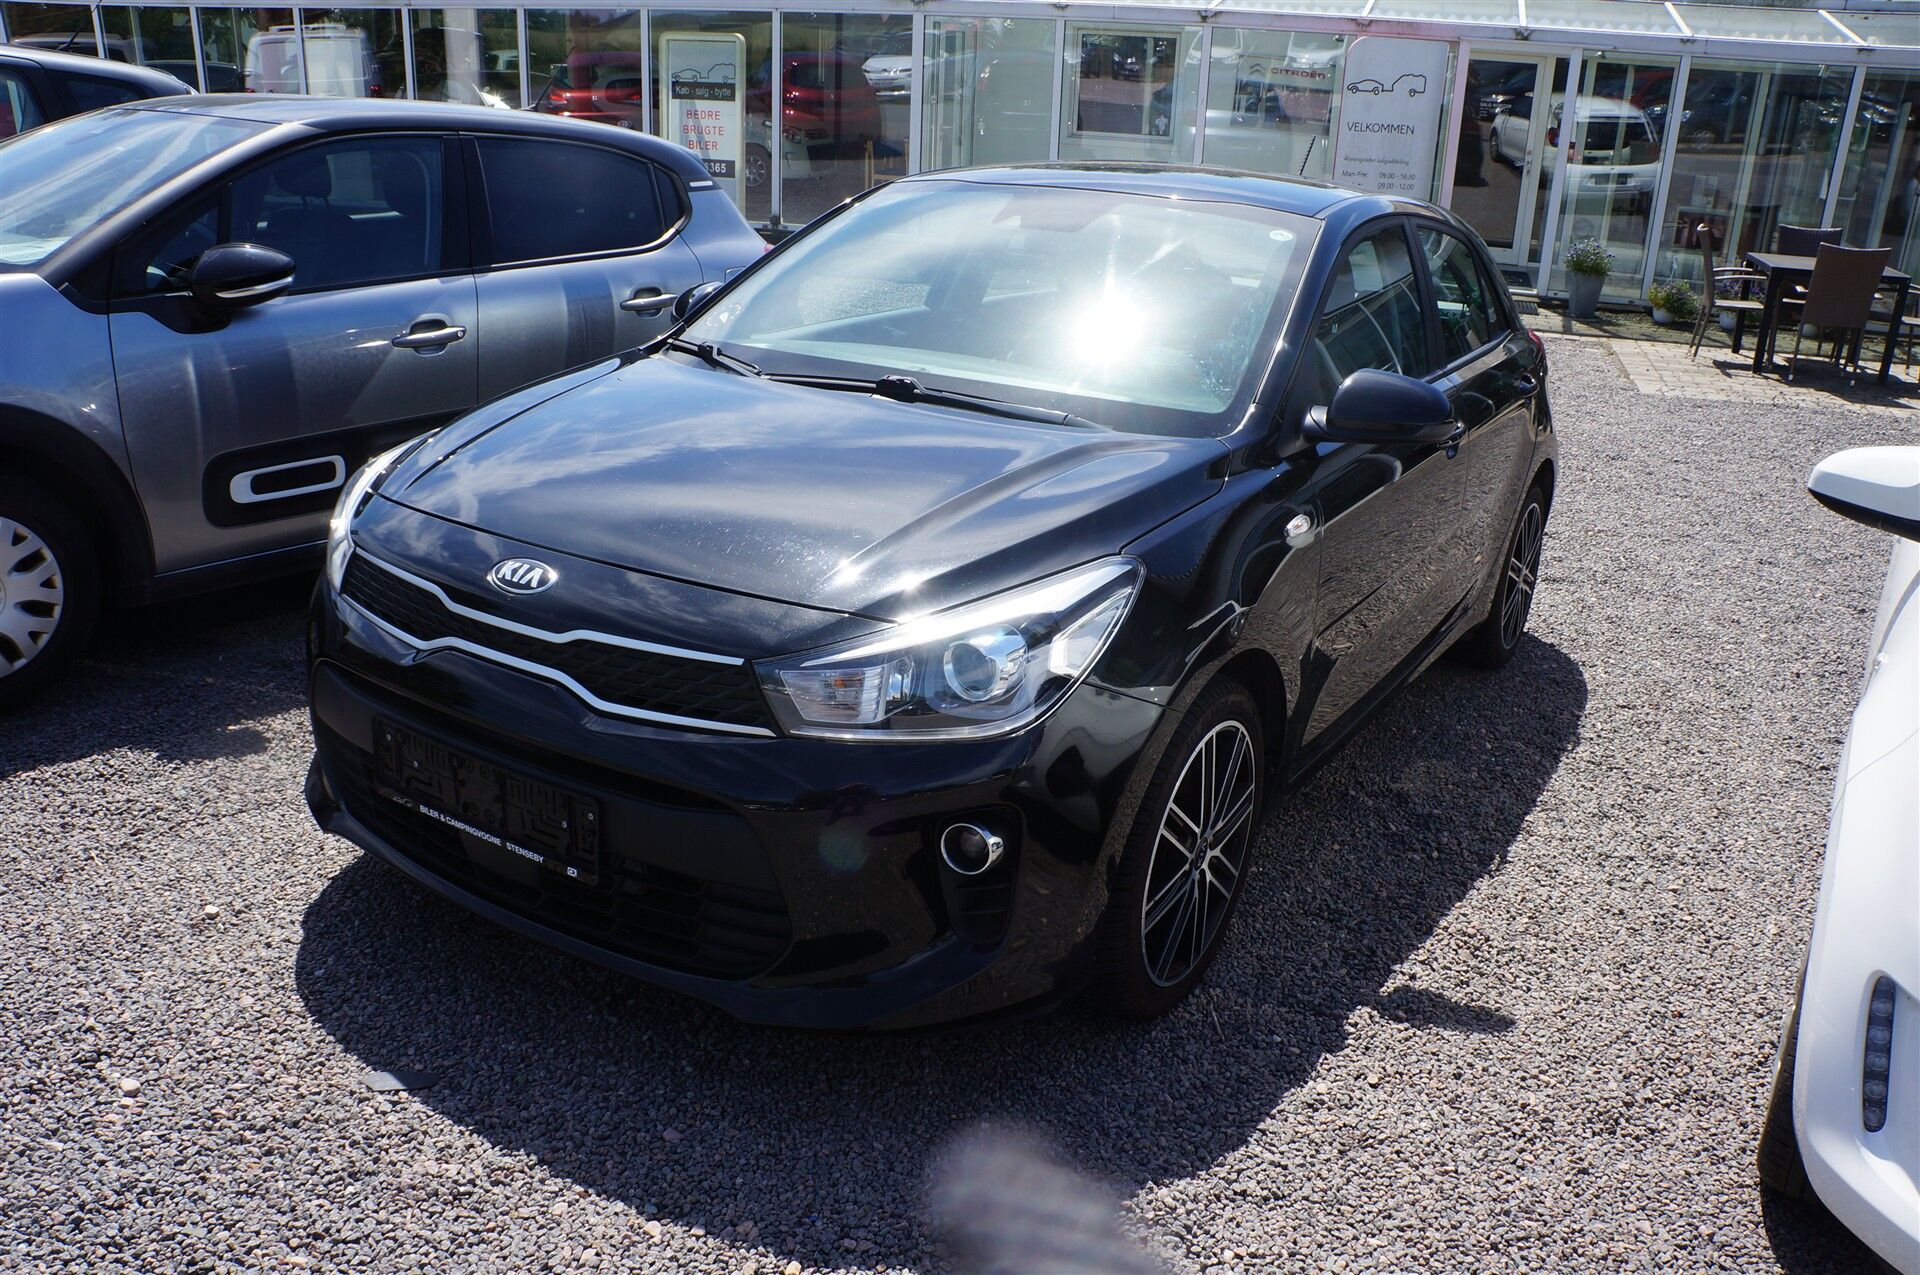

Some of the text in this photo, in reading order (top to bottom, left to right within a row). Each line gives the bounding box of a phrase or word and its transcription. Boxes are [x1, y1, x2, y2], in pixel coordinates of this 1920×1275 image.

[675, 85, 690, 95] Køb
[695, 87, 709, 97] salg
[714, 88, 732, 98] bytte
[686, 109, 721, 120] BEDRE
[683, 124, 725, 136] BRUGTE
[1347, 122, 1415, 135] VELKOMMEN
[688, 140, 718, 151] BILER
[497, 561, 544, 588] KIA
[419, 805, 544, 864] BILER & CAMPINGVOGNE STENSEBY
